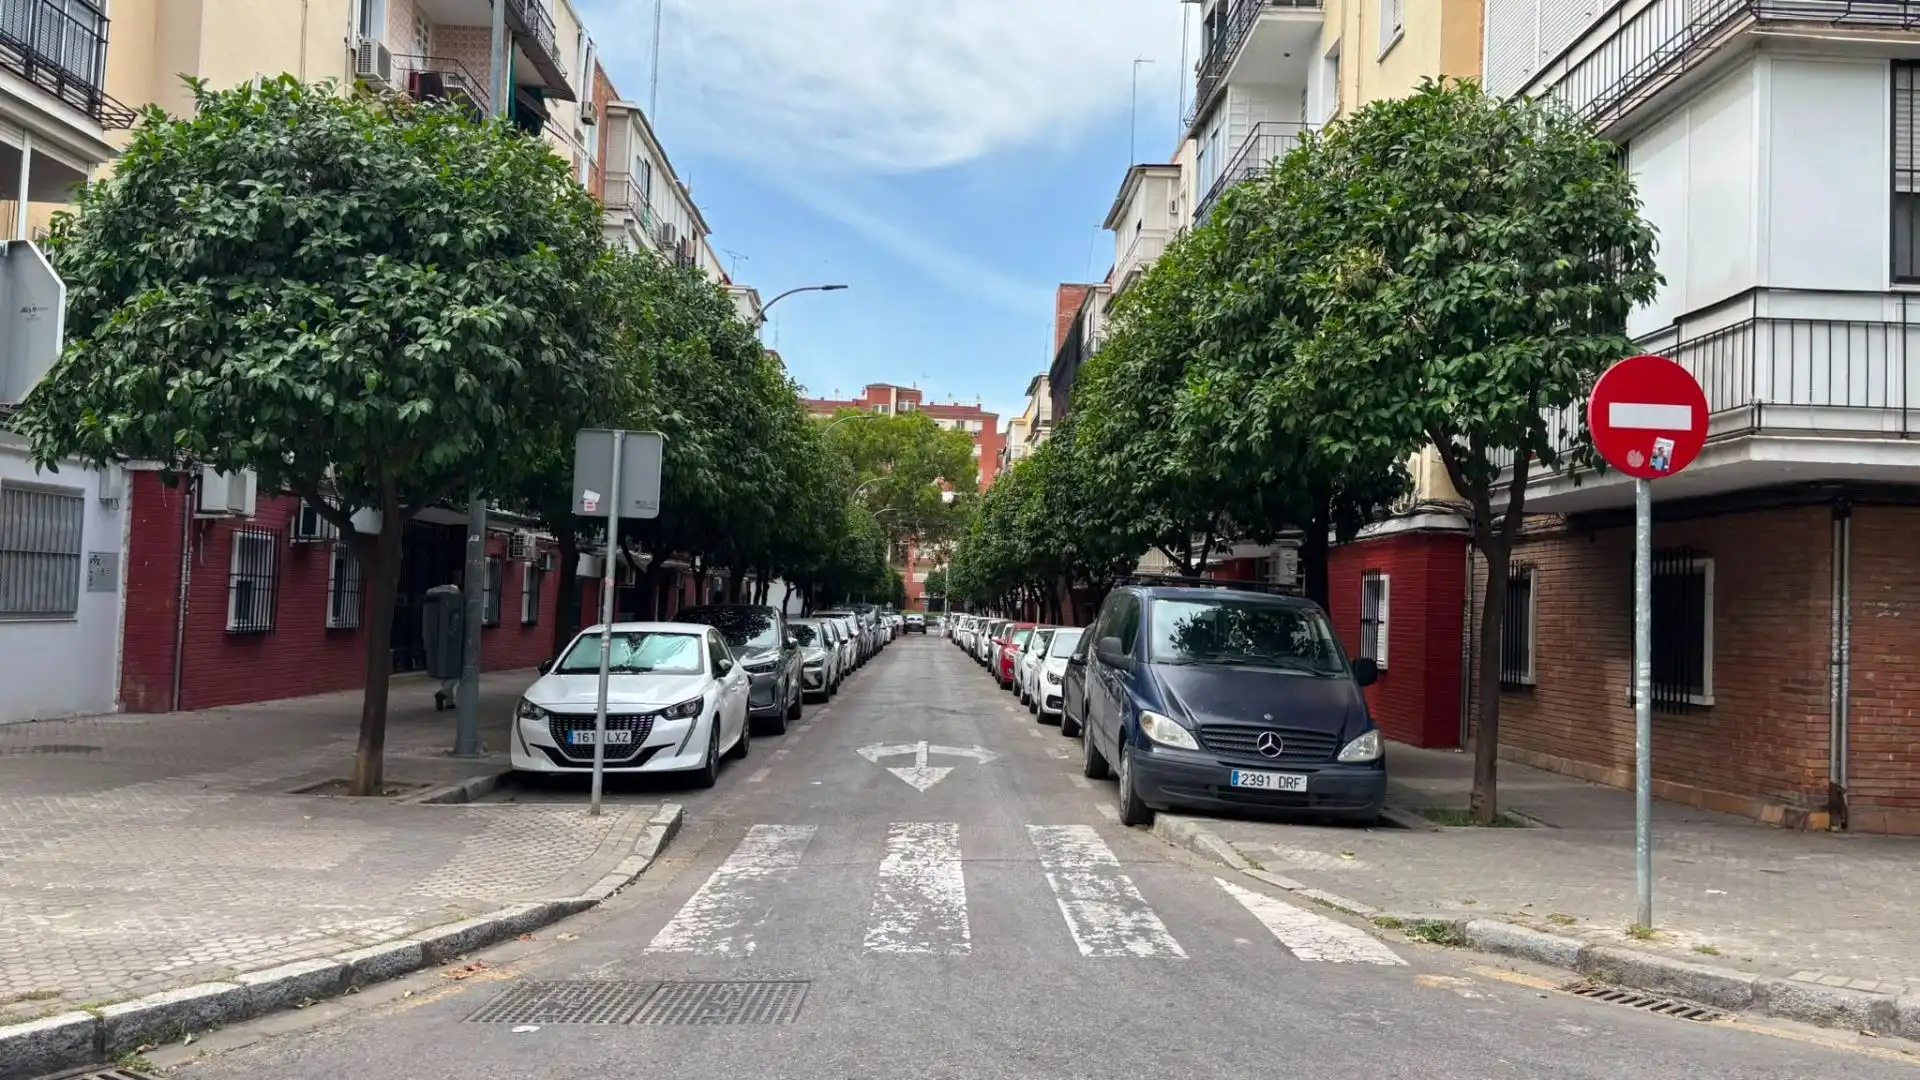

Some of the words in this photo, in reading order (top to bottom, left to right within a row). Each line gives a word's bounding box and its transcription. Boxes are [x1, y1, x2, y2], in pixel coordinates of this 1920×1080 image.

[577, 732, 601, 743] 161
[607, 732, 628, 743] LXZ
[1241, 773, 1270, 787] 2391
[1279, 776, 1301, 789] DRF
